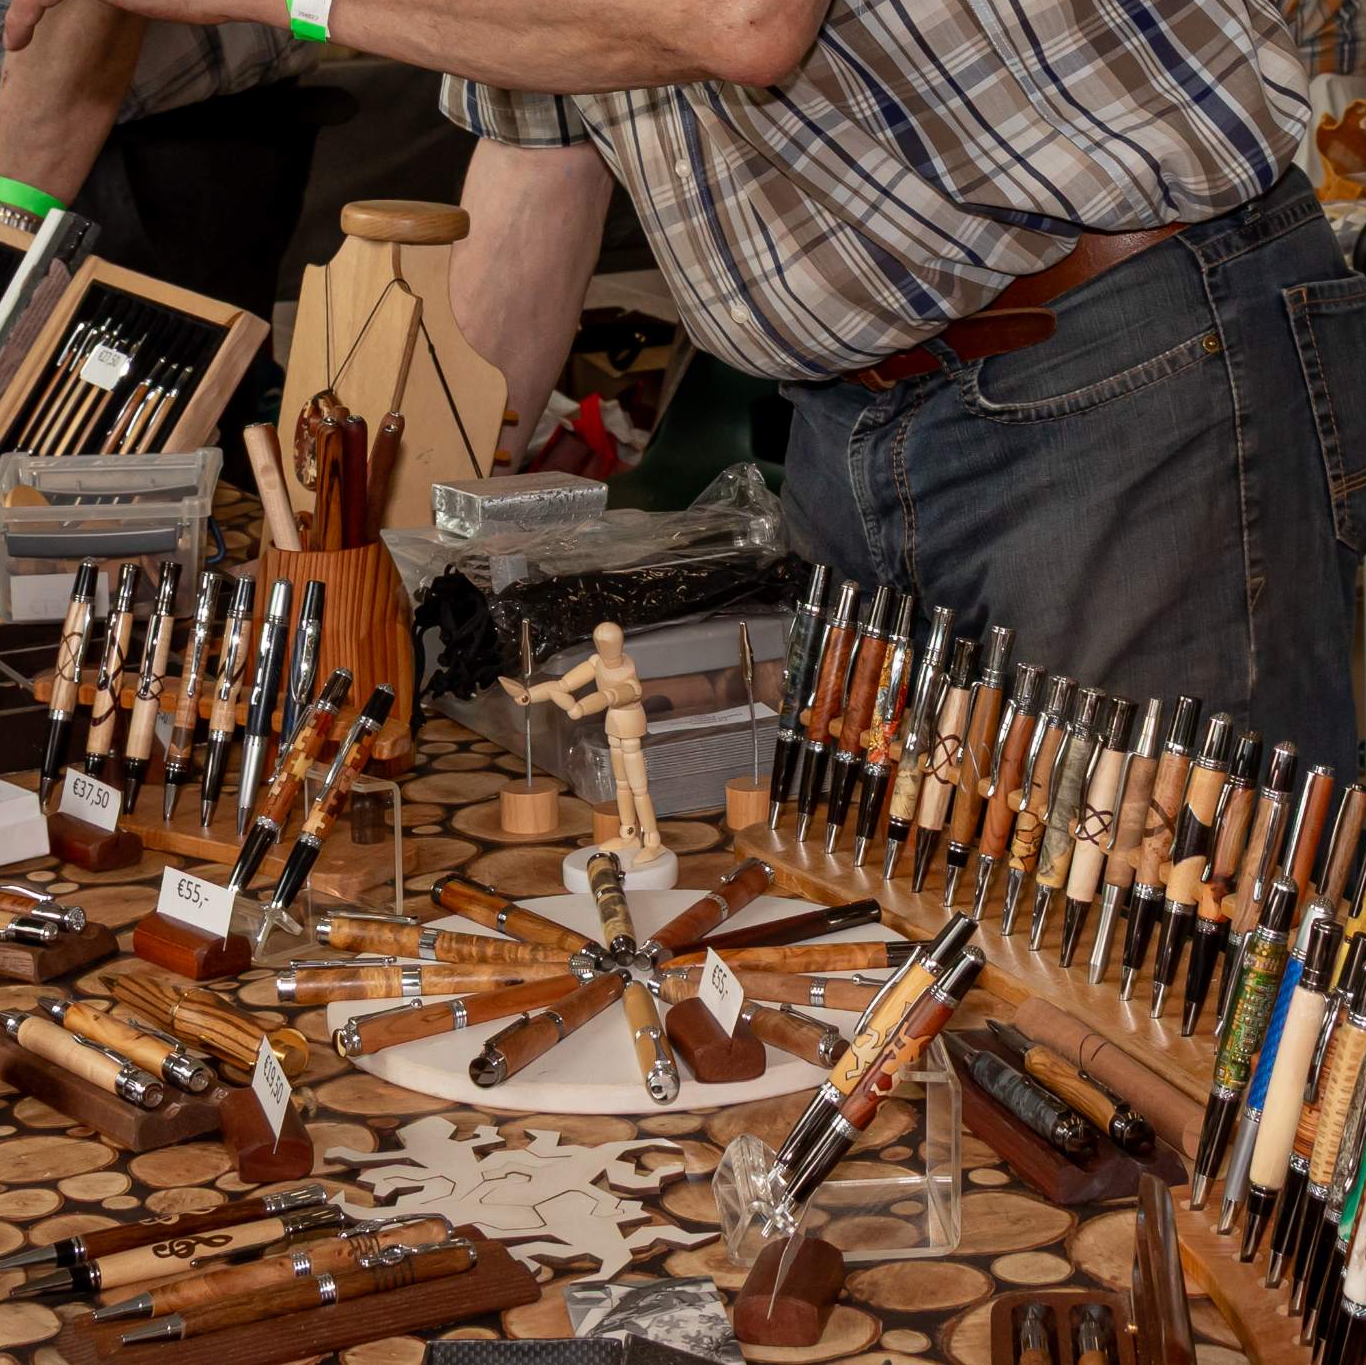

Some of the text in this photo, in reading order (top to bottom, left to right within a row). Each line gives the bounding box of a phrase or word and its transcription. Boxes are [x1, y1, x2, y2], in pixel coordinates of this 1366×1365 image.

[73, 777, 110, 809] €37,50
[177, 878, 209, 909] €55,-
[263, 1055, 284, 1104] €19,50
